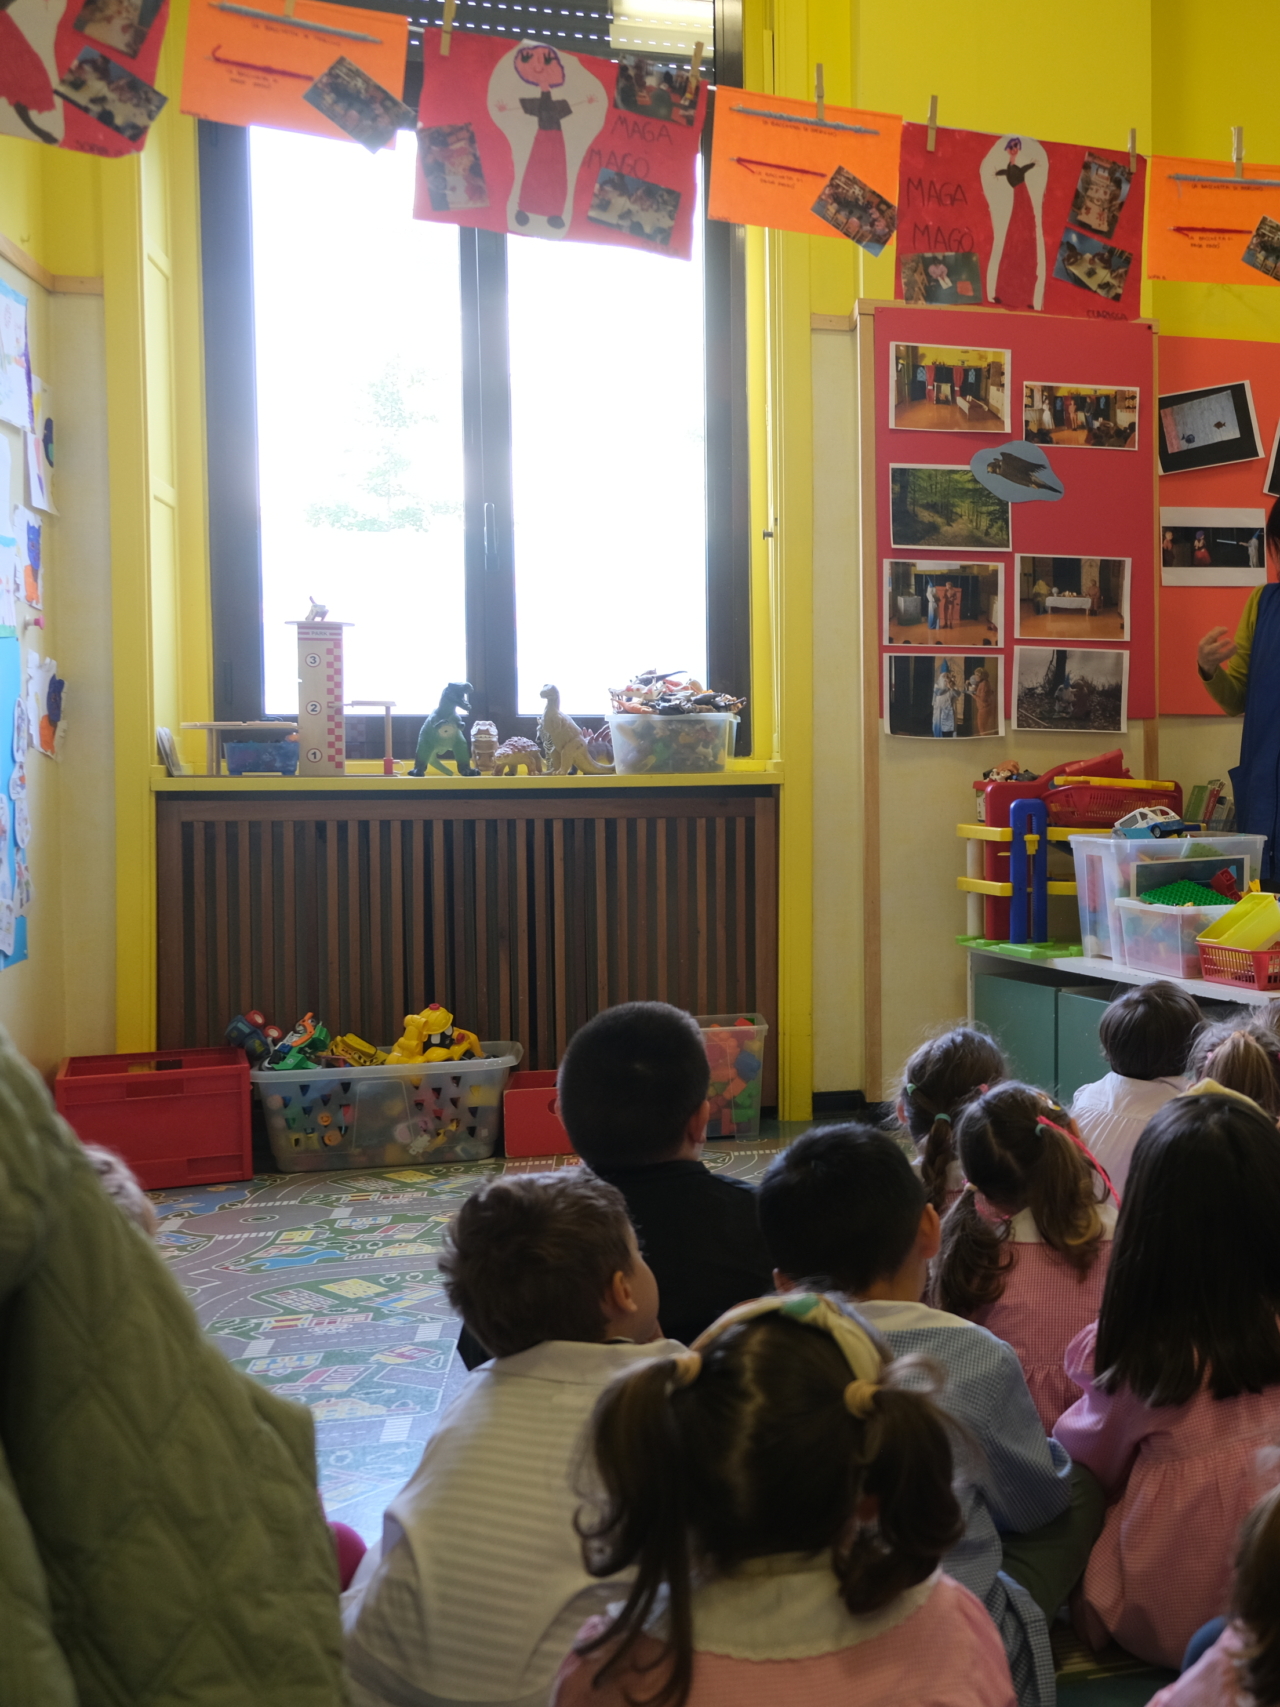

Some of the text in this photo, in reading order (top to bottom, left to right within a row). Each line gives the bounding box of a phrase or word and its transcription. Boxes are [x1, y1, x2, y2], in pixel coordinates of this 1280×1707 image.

[611, 115, 673, 145] MAGA
[906, 177, 968, 207] MAGA
[913, 223, 975, 253] MAGÒ
[310, 656, 317, 664] 3
[310, 703, 318, 713] 2
[311, 751, 317, 760] 1
